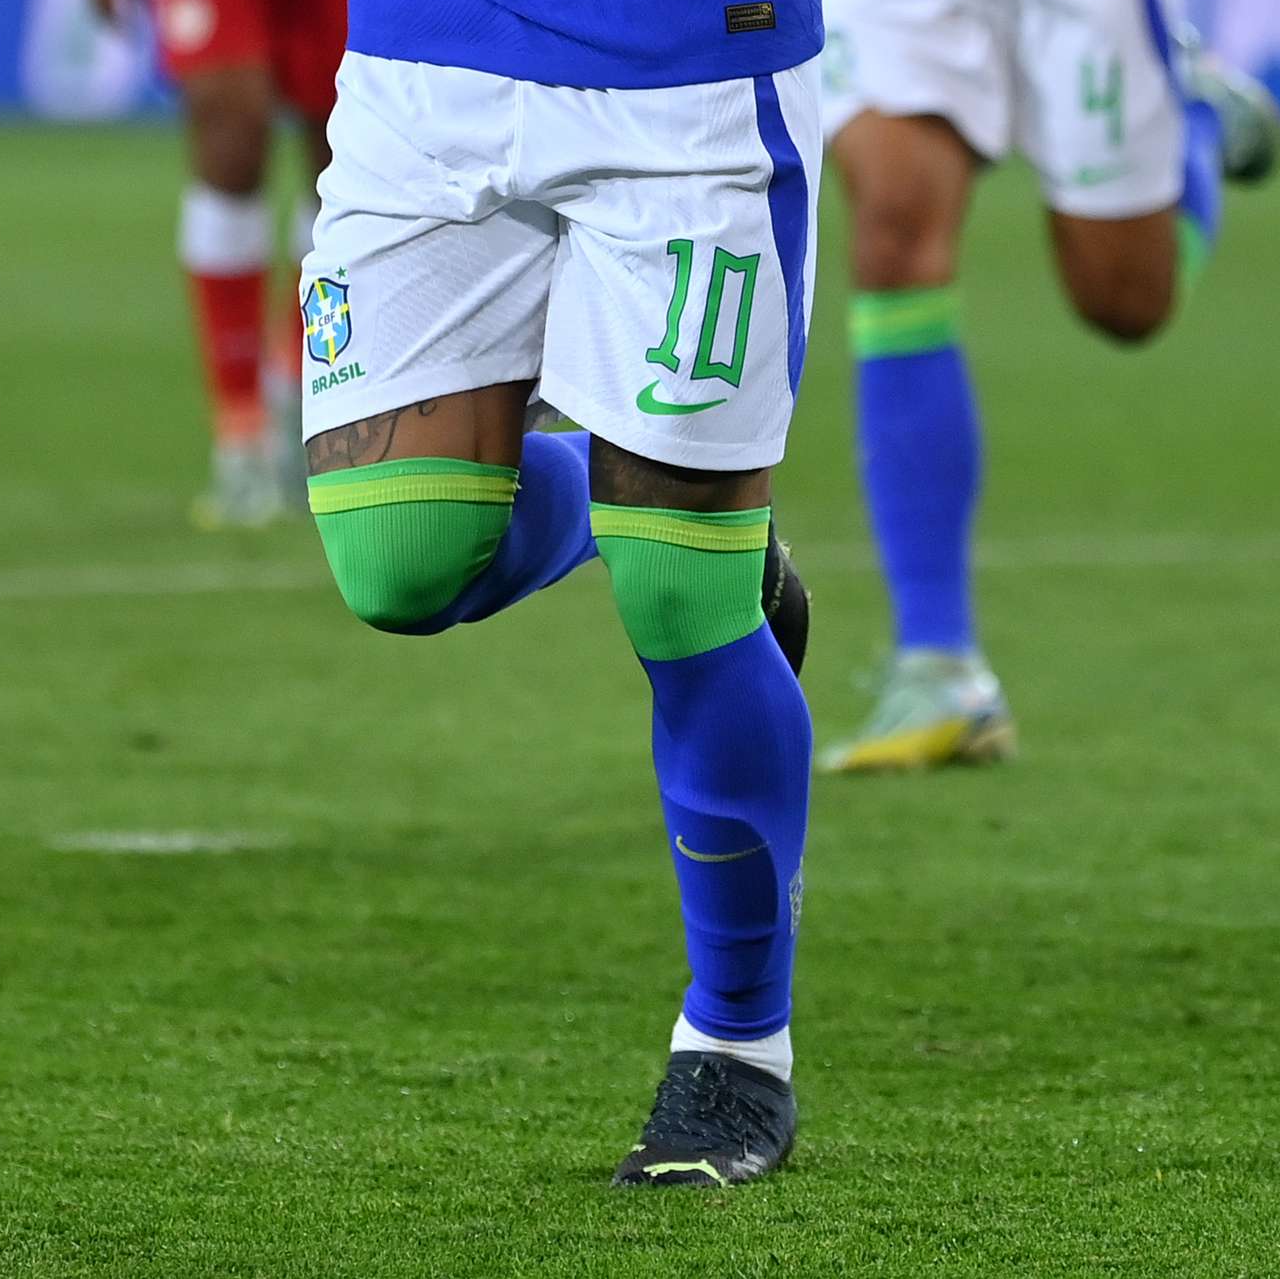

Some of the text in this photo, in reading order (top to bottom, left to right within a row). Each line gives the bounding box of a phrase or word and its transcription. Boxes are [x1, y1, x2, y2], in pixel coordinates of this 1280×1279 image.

[1078, 52, 1124, 147] 4
[318, 311, 336, 327] CBF
[645, 239, 761, 388] 10
[312, 362, 366, 395] BRASIL
